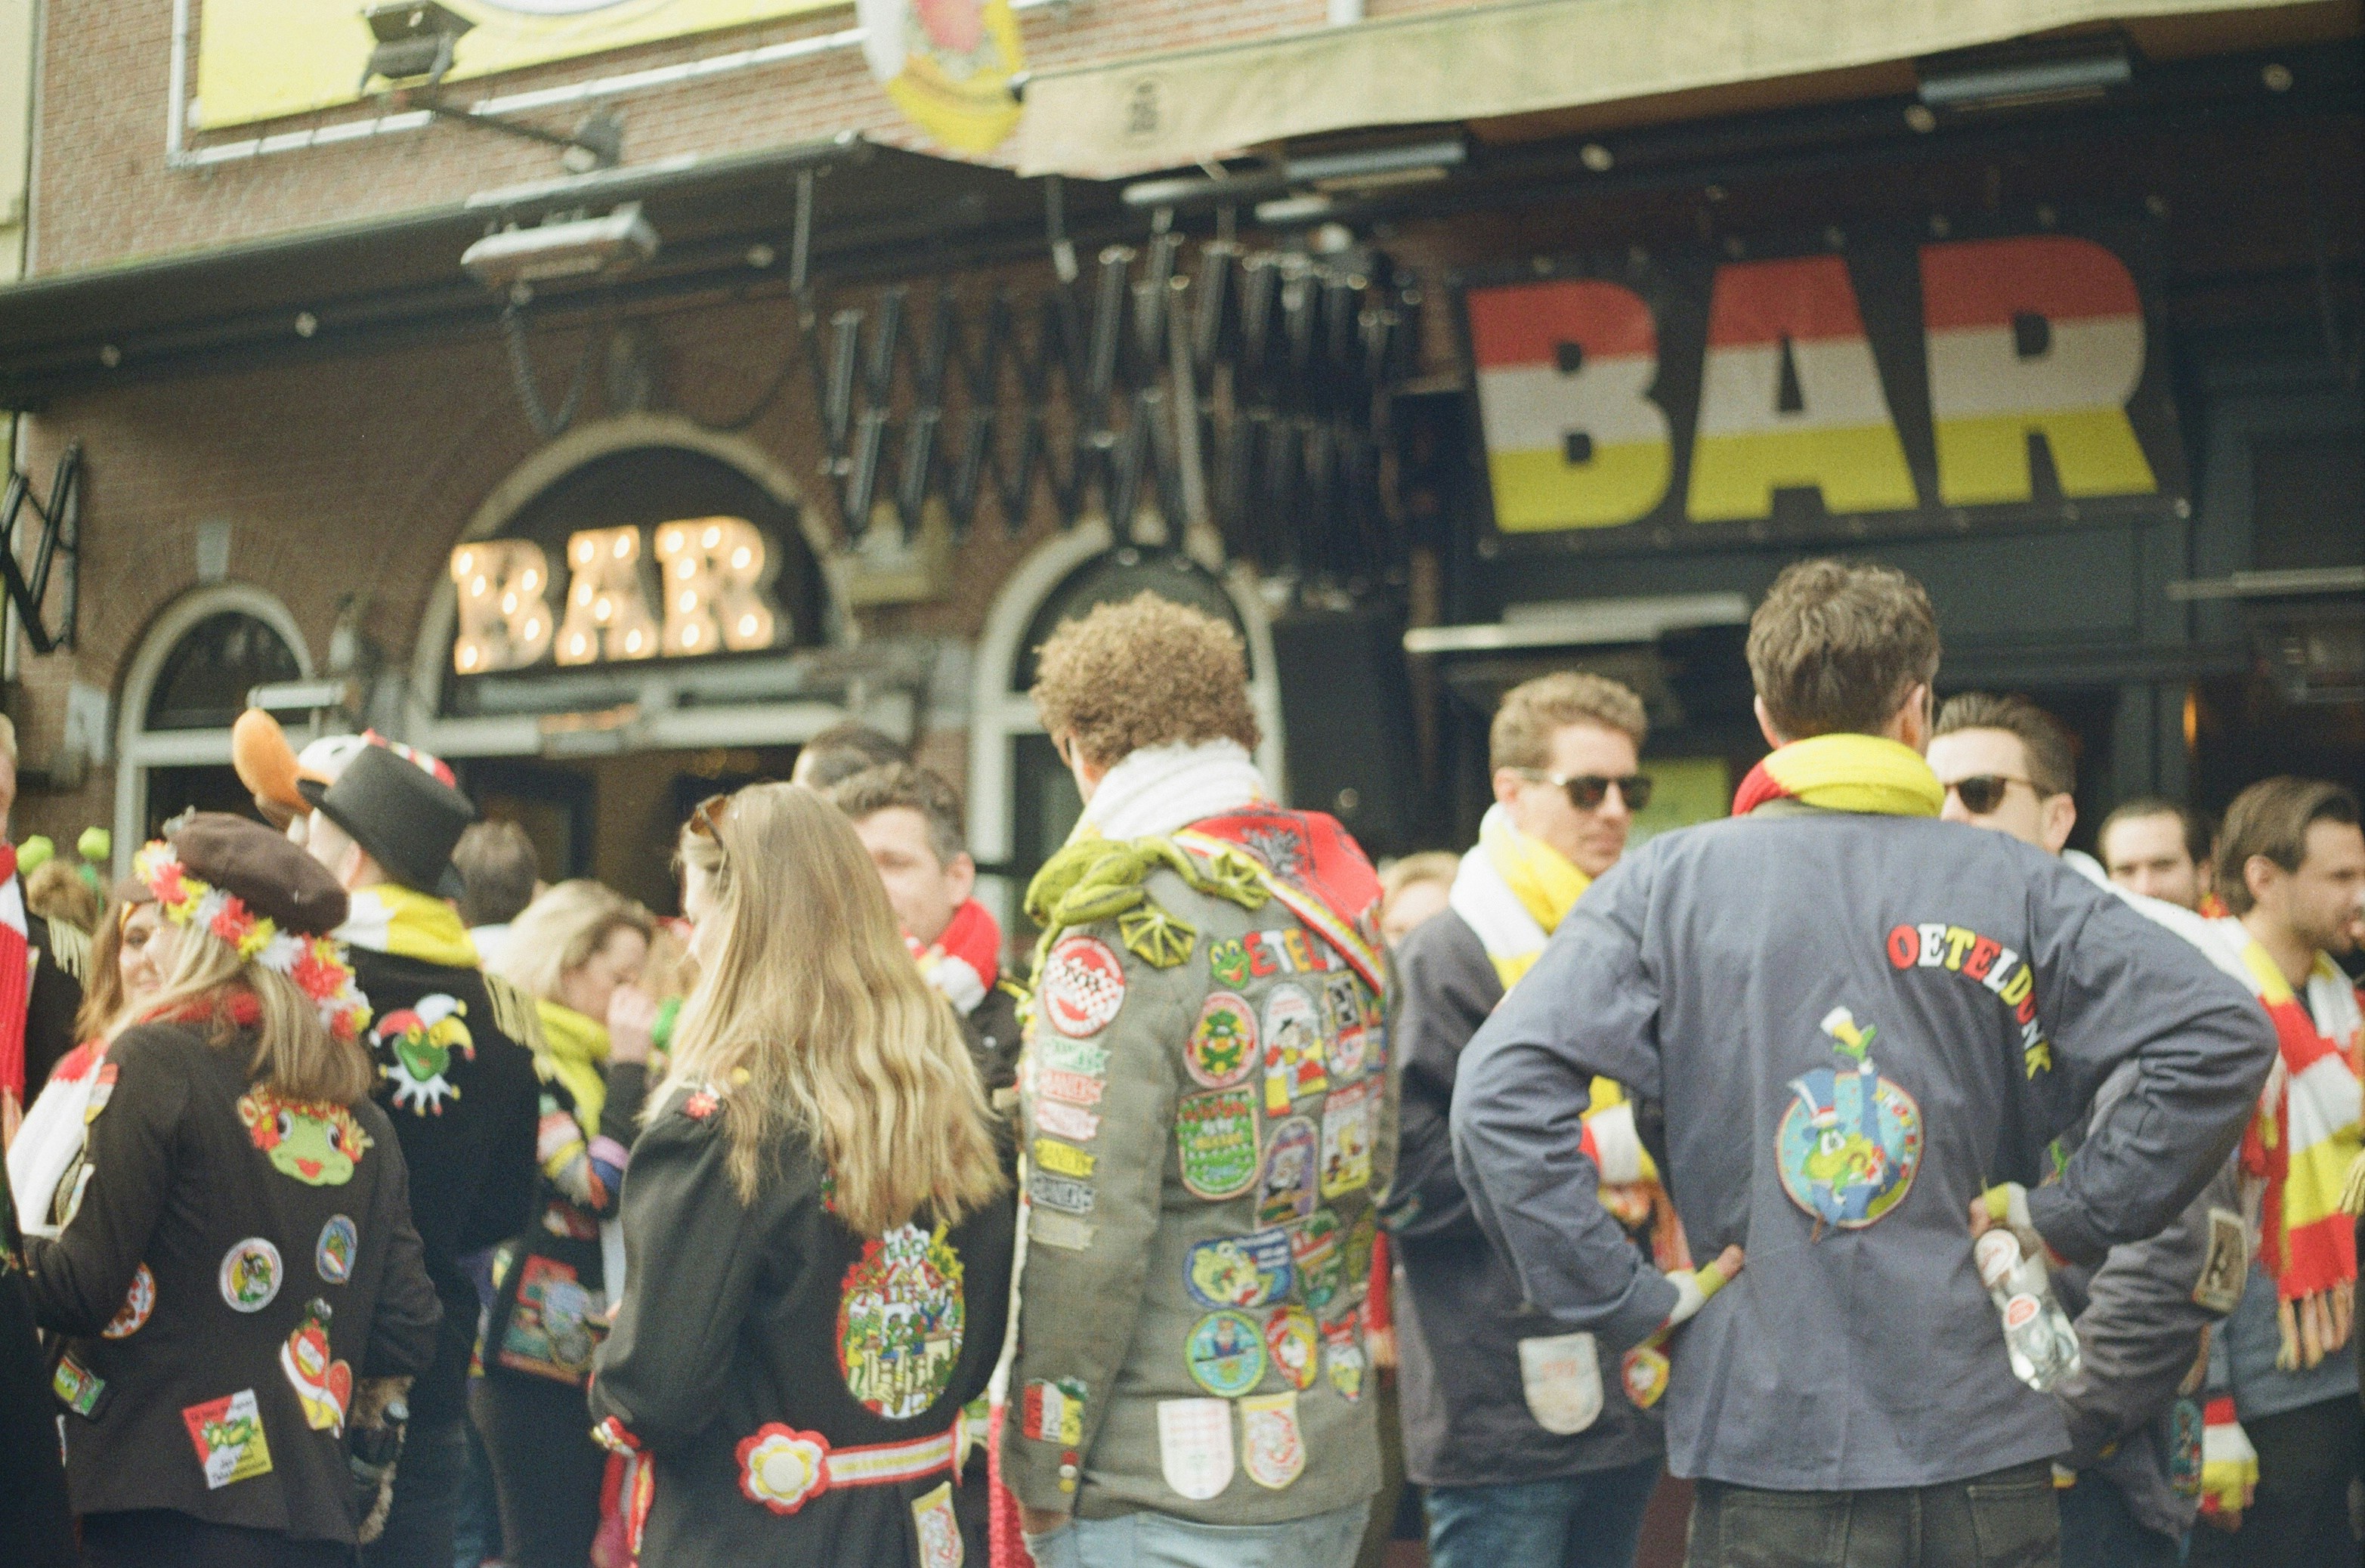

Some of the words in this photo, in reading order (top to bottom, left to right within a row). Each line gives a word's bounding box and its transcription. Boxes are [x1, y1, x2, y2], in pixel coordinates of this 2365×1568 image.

[1467, 235, 2158, 533] BAR
[450, 515, 777, 676] BAR
[1887, 923, 2052, 1081] OETELDONK
